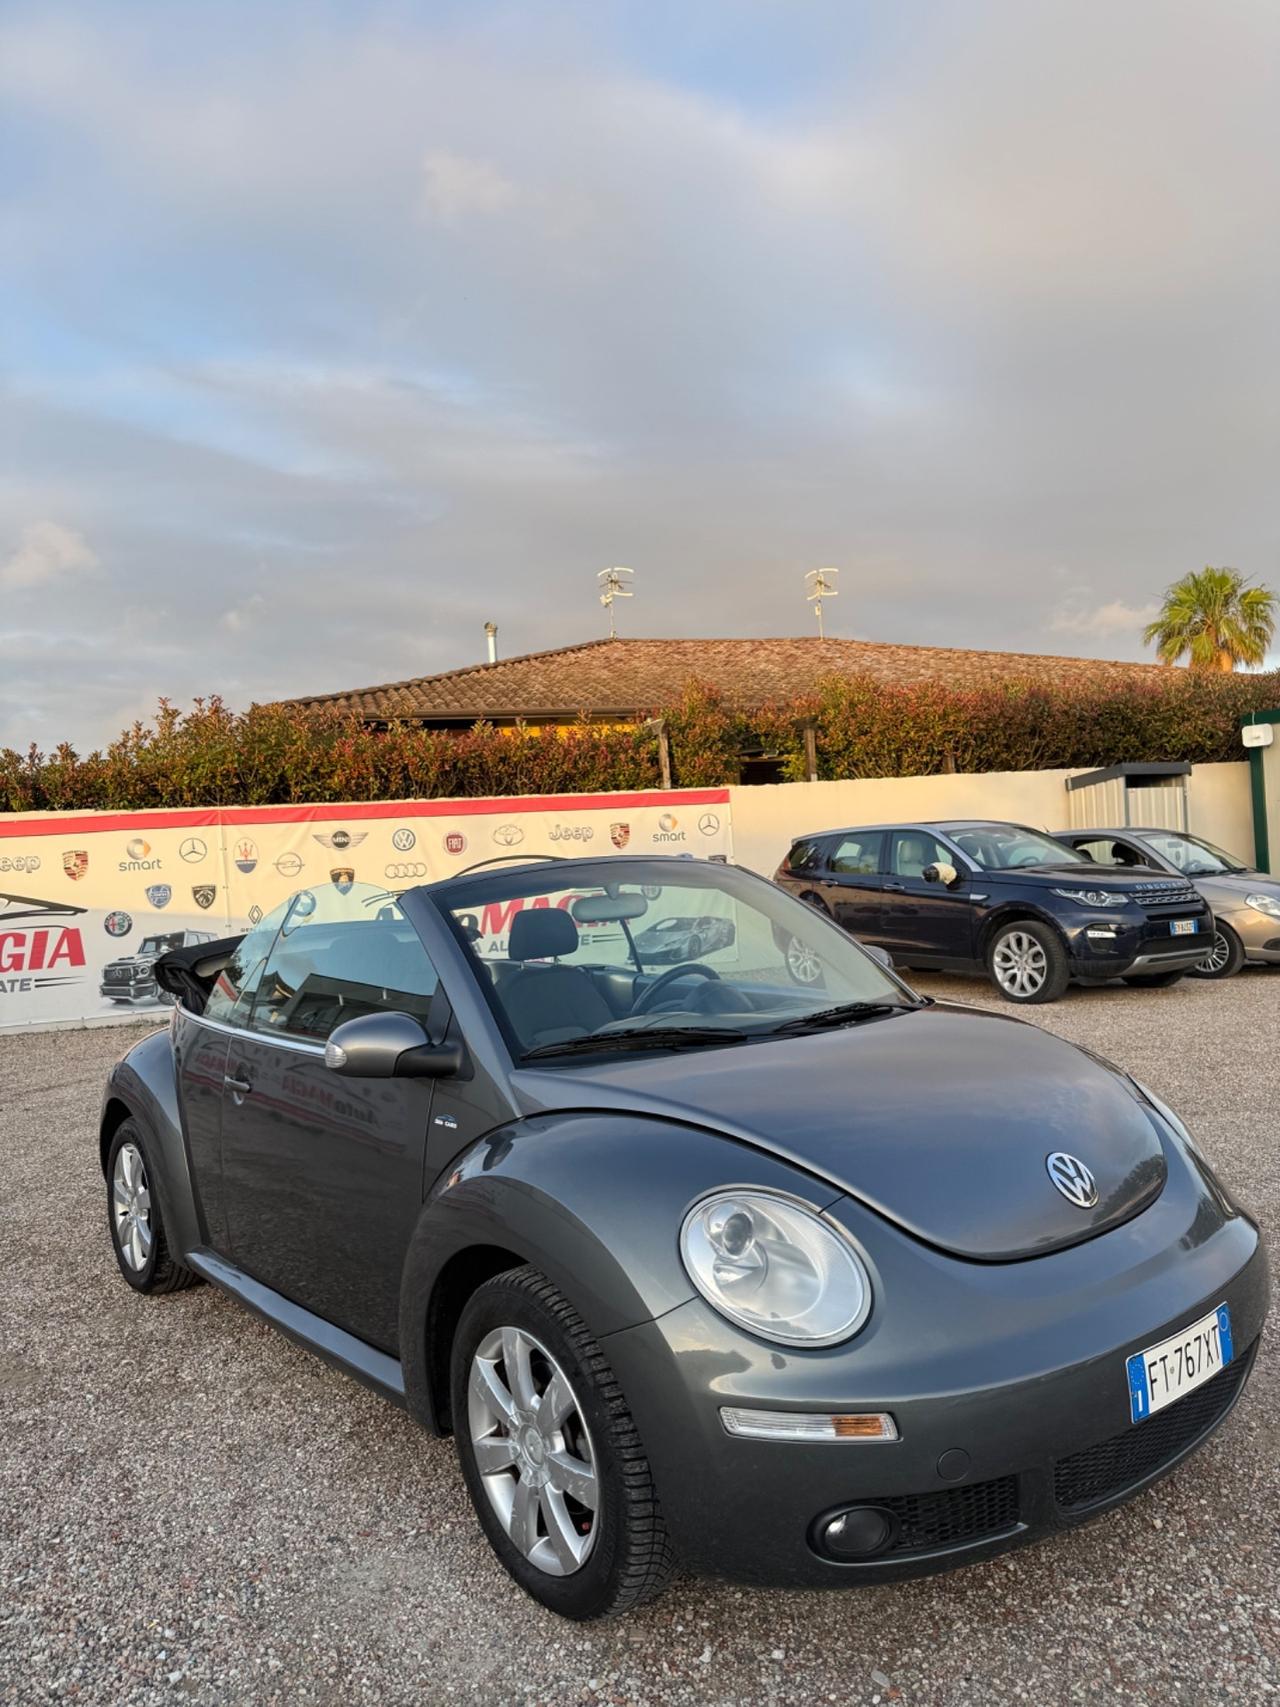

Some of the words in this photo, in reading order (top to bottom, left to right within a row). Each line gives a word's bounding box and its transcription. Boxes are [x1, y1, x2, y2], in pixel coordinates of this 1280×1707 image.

[549, 824, 594, 842] Jeep
[652, 832, 686, 843] smart
[448, 838, 462, 850] FIAT
[118, 859, 162, 872] smart
[1148, 1354, 1169, 1402] FT
[1174, 1324, 1220, 1387] 767XT
